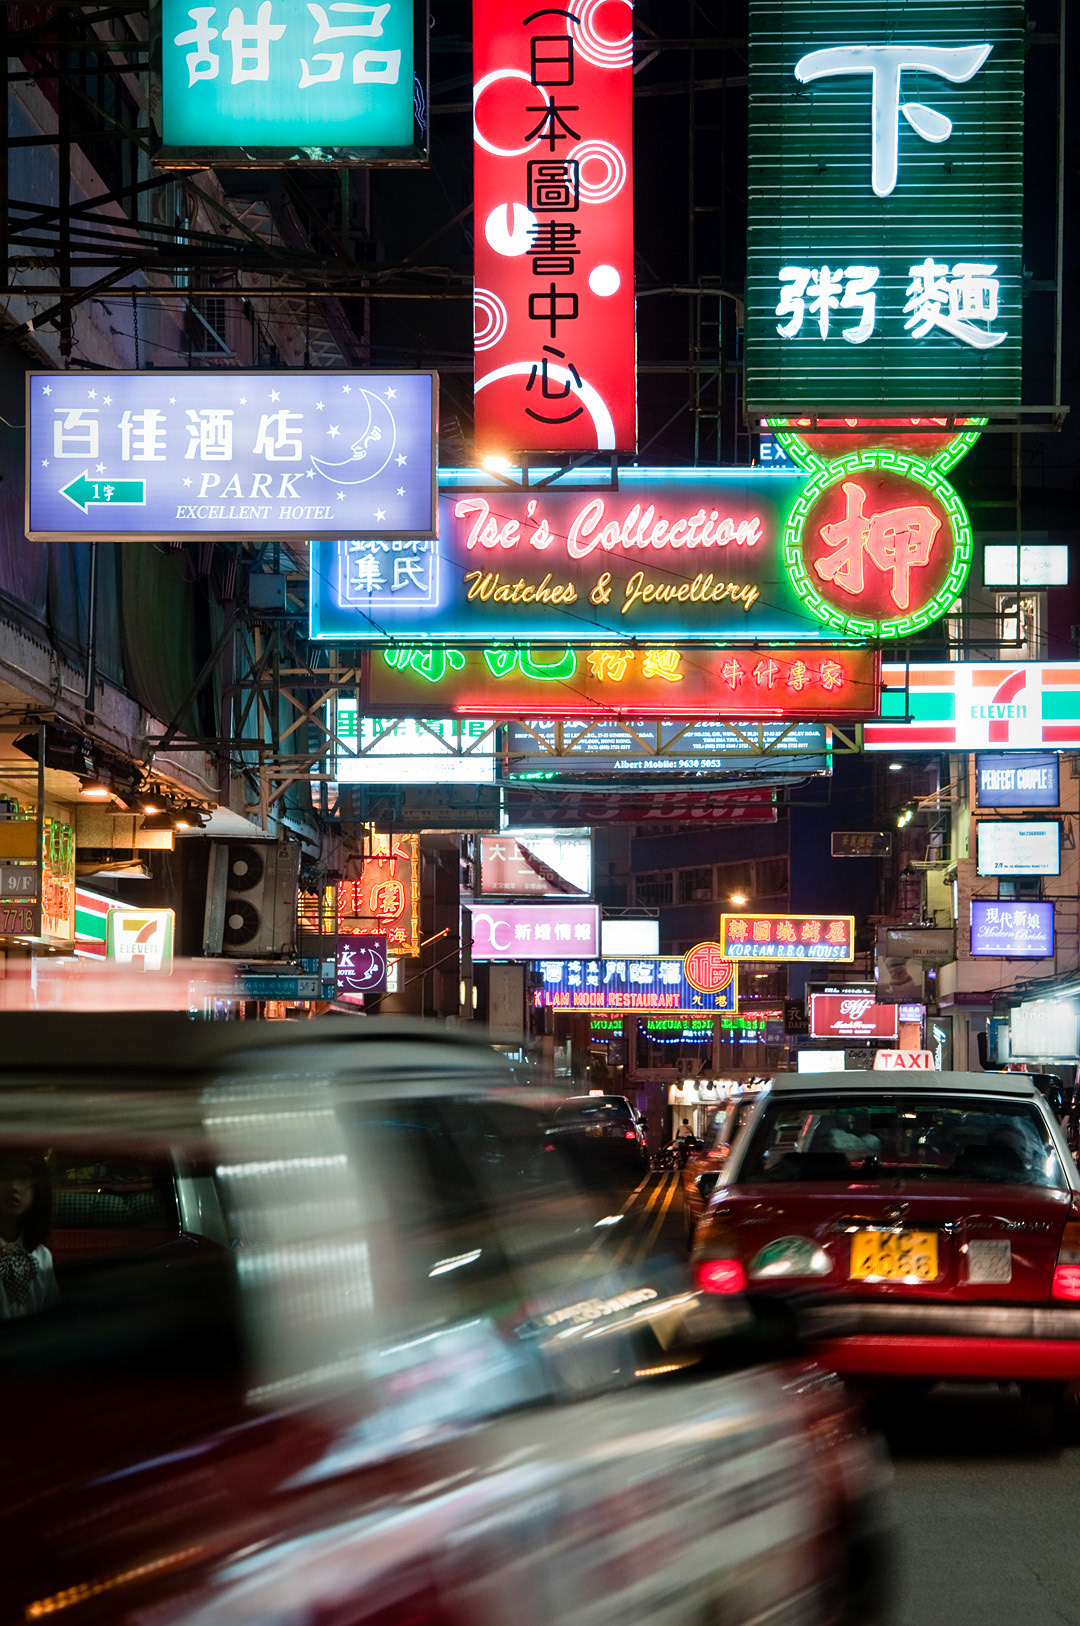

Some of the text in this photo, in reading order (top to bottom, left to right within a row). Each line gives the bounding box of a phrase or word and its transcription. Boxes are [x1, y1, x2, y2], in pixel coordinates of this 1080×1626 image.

[175, 1, 401, 89] 甜品
[795, 44, 994, 197] 下
[776, 258, 1008, 349] 粥麵
[53, 408, 304, 462] 百佳酒店
[198, 472, 304, 499] PARK
[175, 505, 335, 520] EXCELLENT HOTEL
[455, 498, 763, 559] Tse's Collection
[813, 482, 941, 609] 押
[464, 570, 760, 614] Watches & Jewellery
[614, 760, 721, 769] Albert Mobile: 9630 5053
[981, 769, 1016, 790] PERFECT
[1016, 769, 1047, 790] COUPLE
[8, 876, 32, 891] 9/F
[3, 910, 33, 932] 7716
[986, 908, 1040, 929] 現代新娘
[977, 925, 1046, 941] Modern Brides
[727, 944, 775, 956] KOREAN
[807, 946, 847, 957] HOUSE
[545, 992, 570, 1006] LAM
[573, 992, 605, 1006] MOON
[608, 992, 681, 1008] RESTAURANT
[880, 1053, 929, 1069] TAXI
